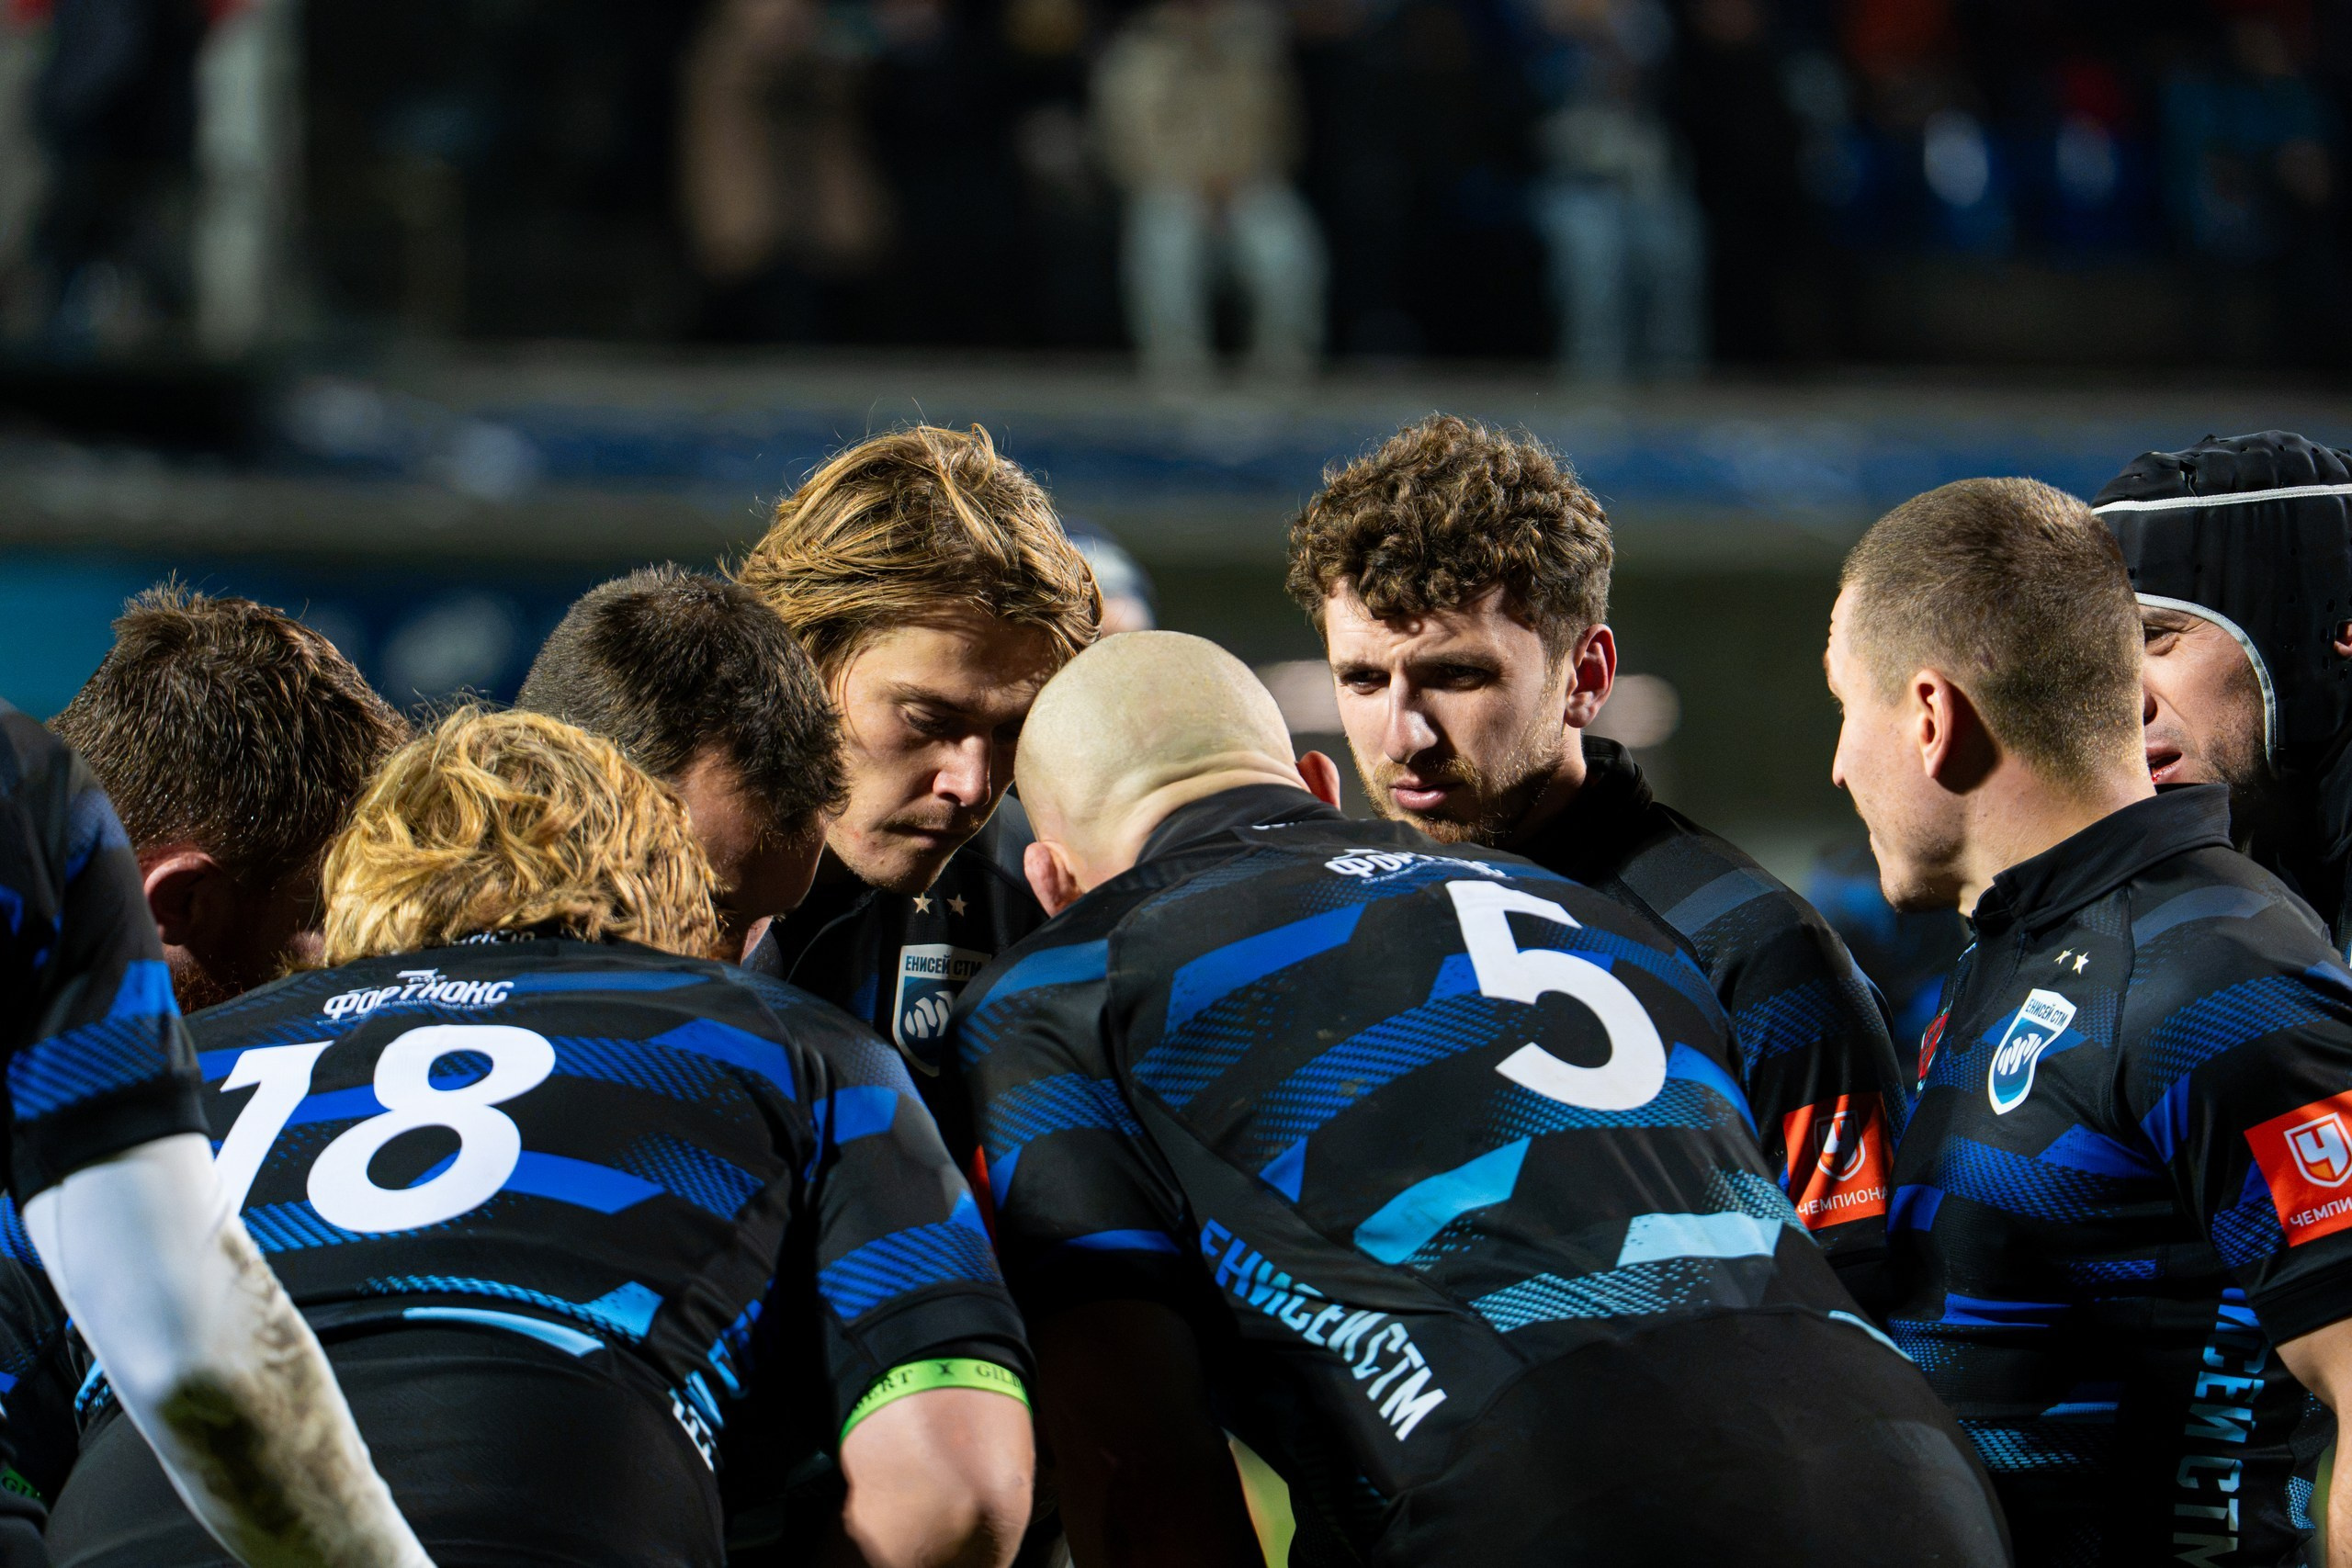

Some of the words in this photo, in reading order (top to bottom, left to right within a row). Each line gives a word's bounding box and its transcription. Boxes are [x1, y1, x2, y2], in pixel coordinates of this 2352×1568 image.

[905, 953, 951, 975] ЕНИСЕЙ
[322, 979, 514, 1020] ФОРТНОКС
[1447, 880, 1667, 1111] 5
[2025, 998, 2056, 1021] ЕНИСЕЙ
[2051, 1010, 2069, 1027] СТМ
[220, 1024, 557, 1234] 18
